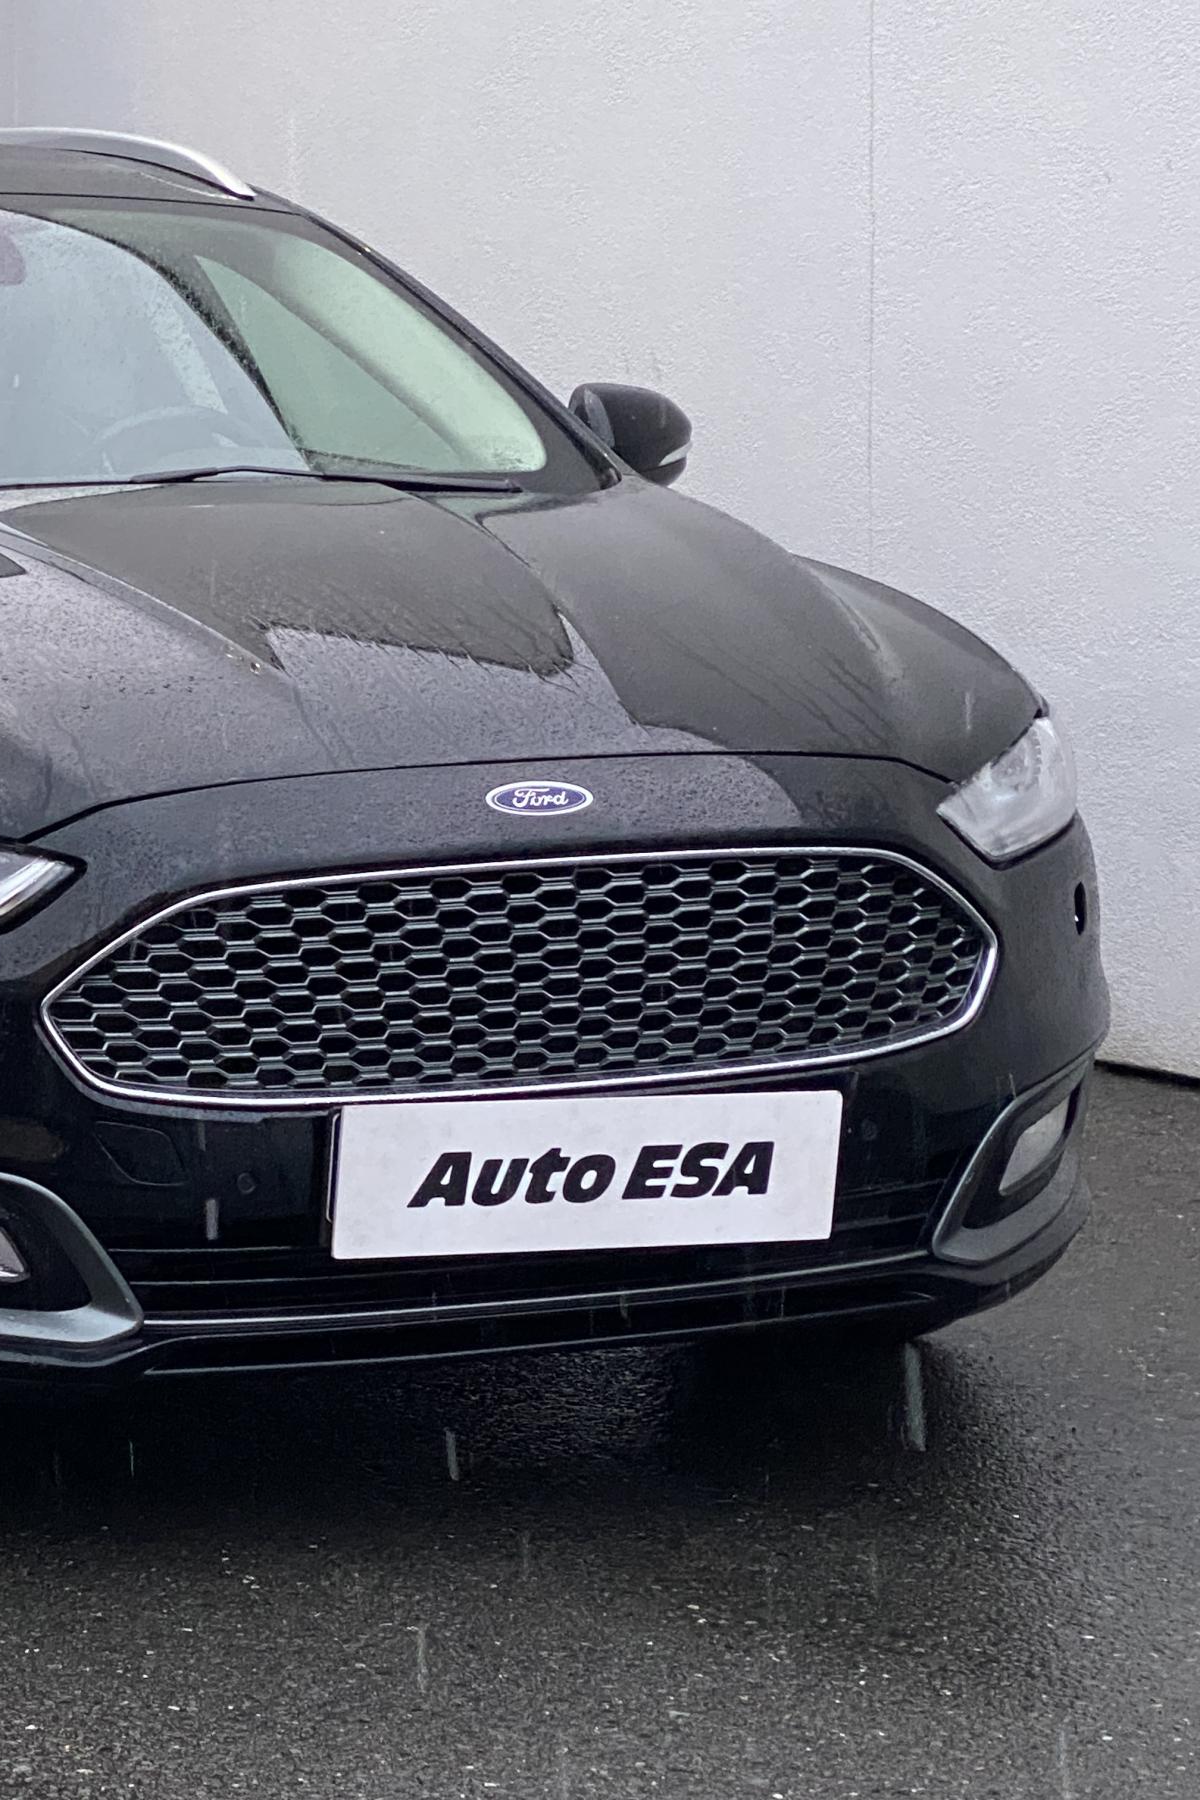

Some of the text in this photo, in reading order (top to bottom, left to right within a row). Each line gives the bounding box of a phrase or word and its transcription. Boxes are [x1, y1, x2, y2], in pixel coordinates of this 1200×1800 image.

[512, 788, 569, 808] Ford
[406, 1141, 775, 1208] Auto ESA
